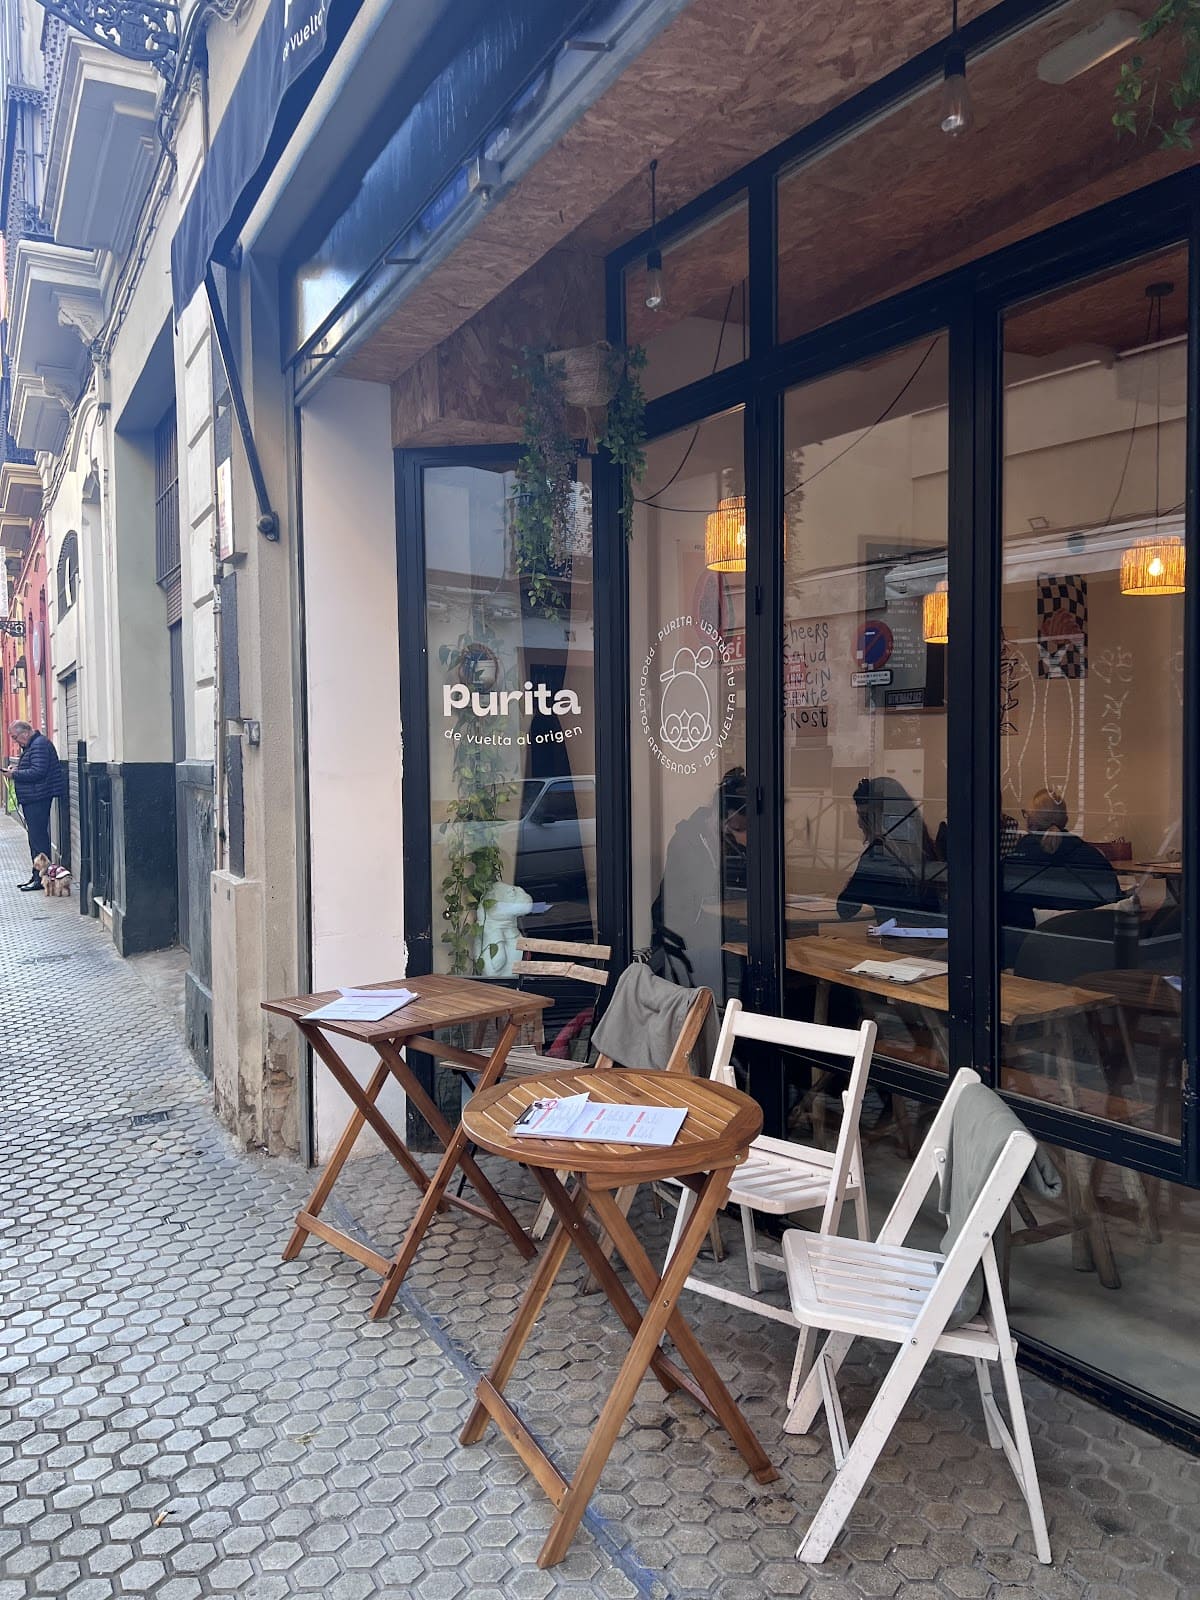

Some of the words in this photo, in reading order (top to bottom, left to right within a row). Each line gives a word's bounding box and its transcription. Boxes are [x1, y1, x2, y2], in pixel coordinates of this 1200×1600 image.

[657, 616, 693, 641] PURITA
[700, 621, 731, 663] ORIGEN
[727, 667, 736, 687] AL
[639, 647, 655, 735] PRODUCTOS
[647, 737, 697, 775] ARTESANOS
[717, 693, 736, 749] VUELTA
[444, 728, 462, 741] de
[467, 733, 511, 746] vuelta
[517, 733, 532, 746] al
[535, 726, 583, 744] origen
[705, 749, 717, 767] DE
